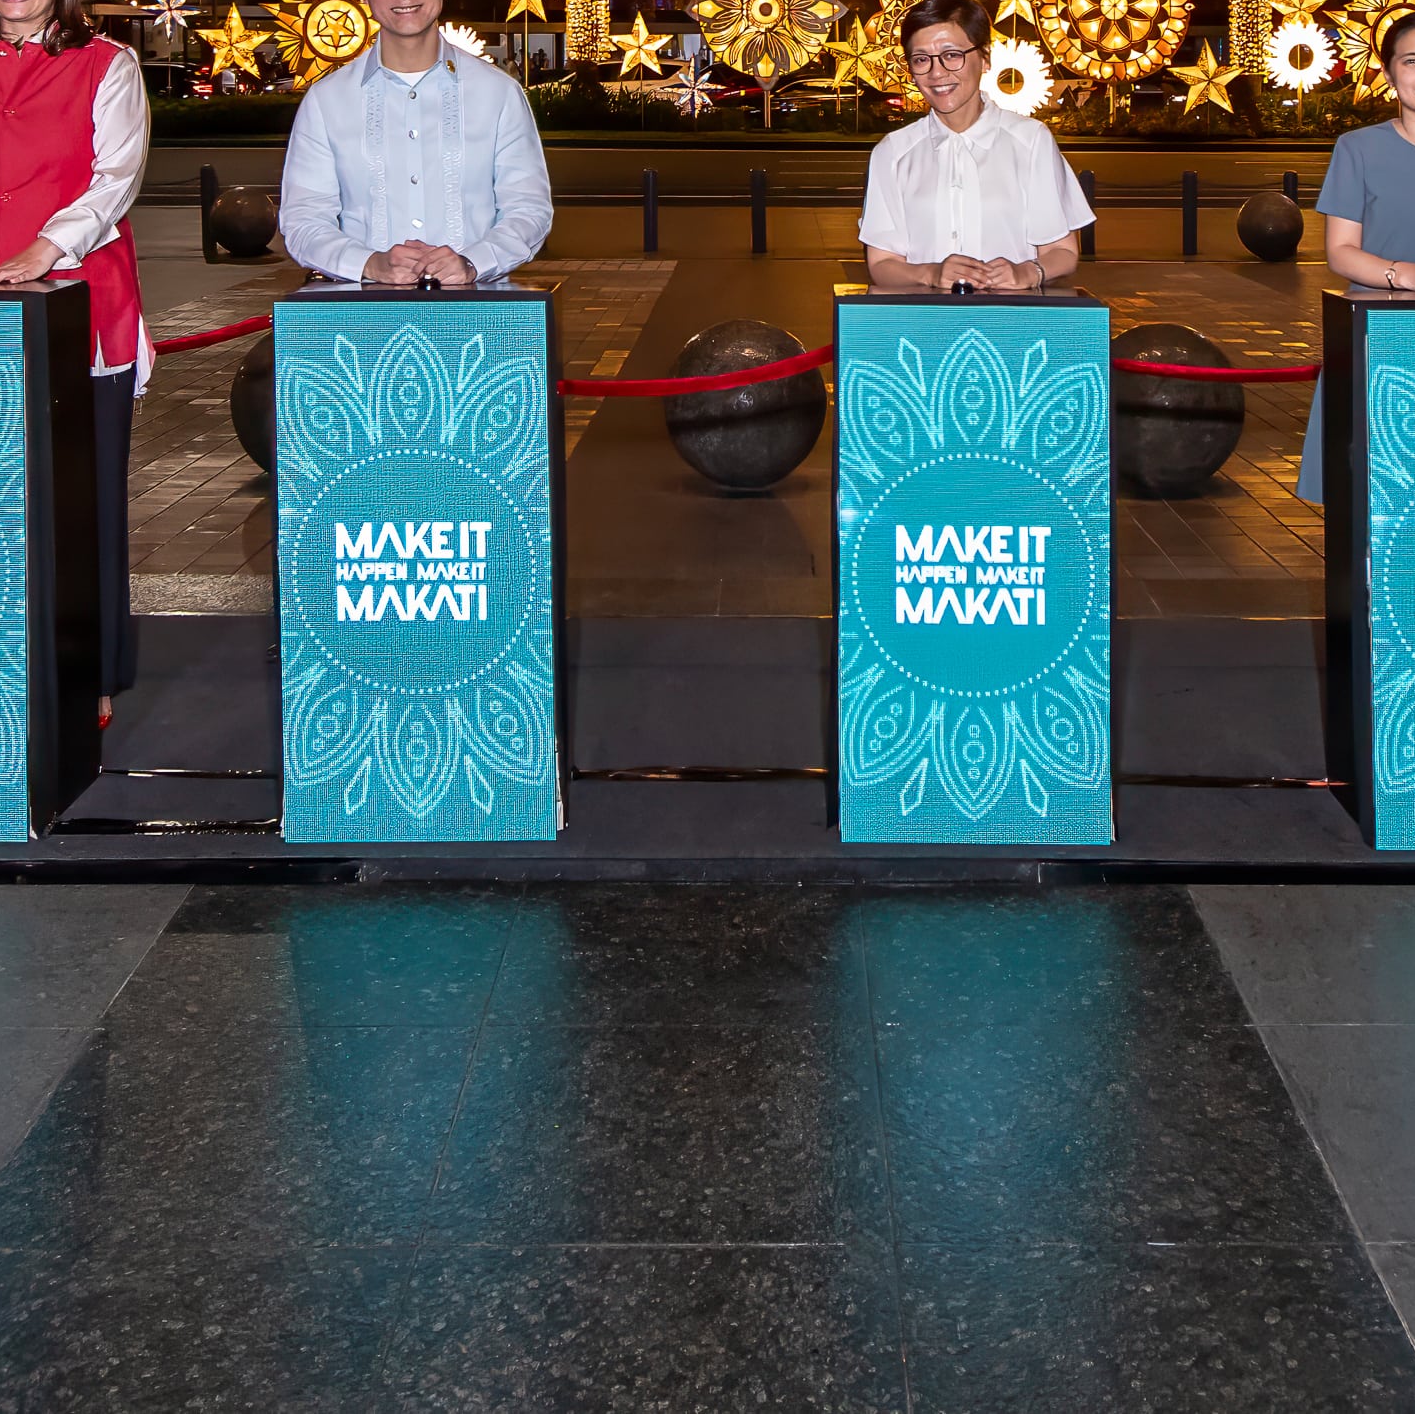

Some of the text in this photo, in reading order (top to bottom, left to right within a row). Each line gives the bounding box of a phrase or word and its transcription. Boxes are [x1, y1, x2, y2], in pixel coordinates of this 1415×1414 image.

[337, 562, 408, 580] HAPPEN
[896, 565, 967, 583] HAPPEN
[336, 584, 487, 621] MAKATI
[895, 588, 1046, 625] MAKATI
